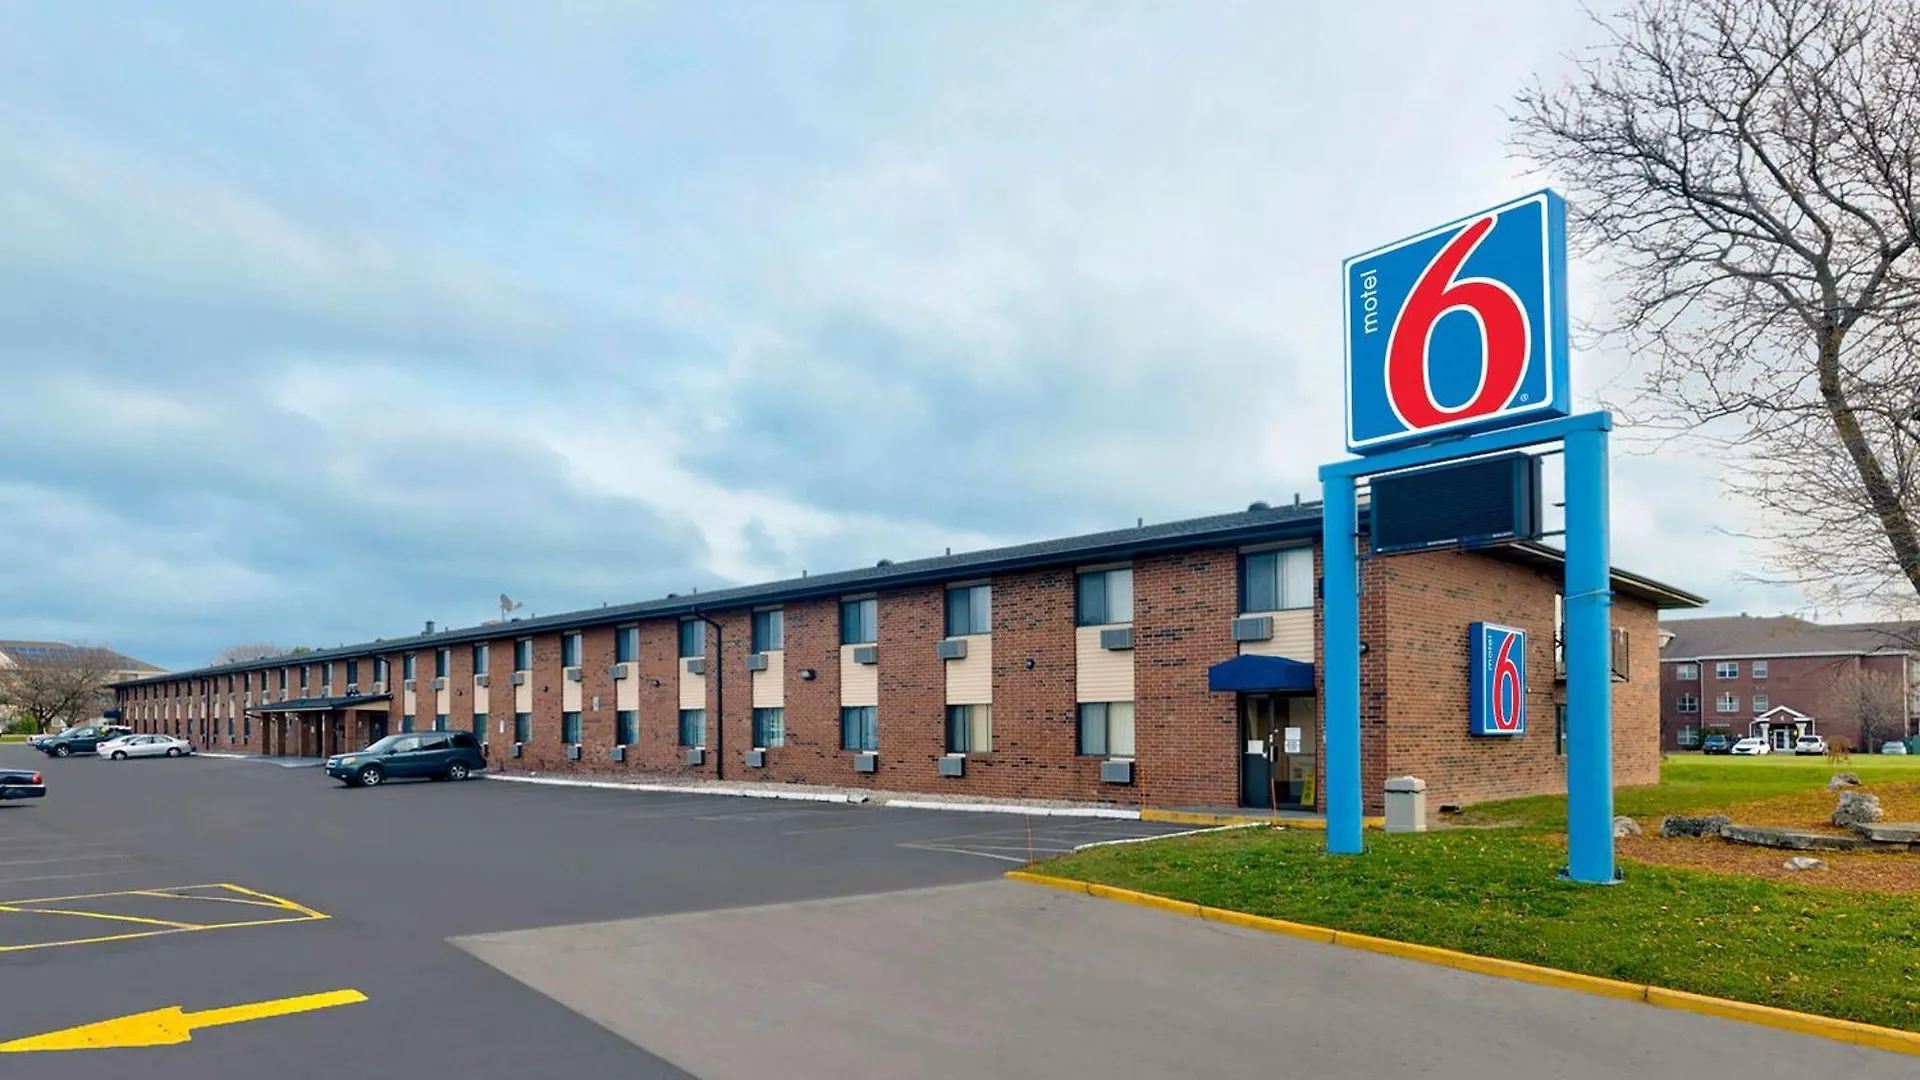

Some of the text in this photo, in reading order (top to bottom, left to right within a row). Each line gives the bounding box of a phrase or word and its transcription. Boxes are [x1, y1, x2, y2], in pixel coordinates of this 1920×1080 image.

[1360, 269, 1378, 334] motel
[1384, 214, 1532, 432] 6
[1492, 631, 1520, 729] 6
